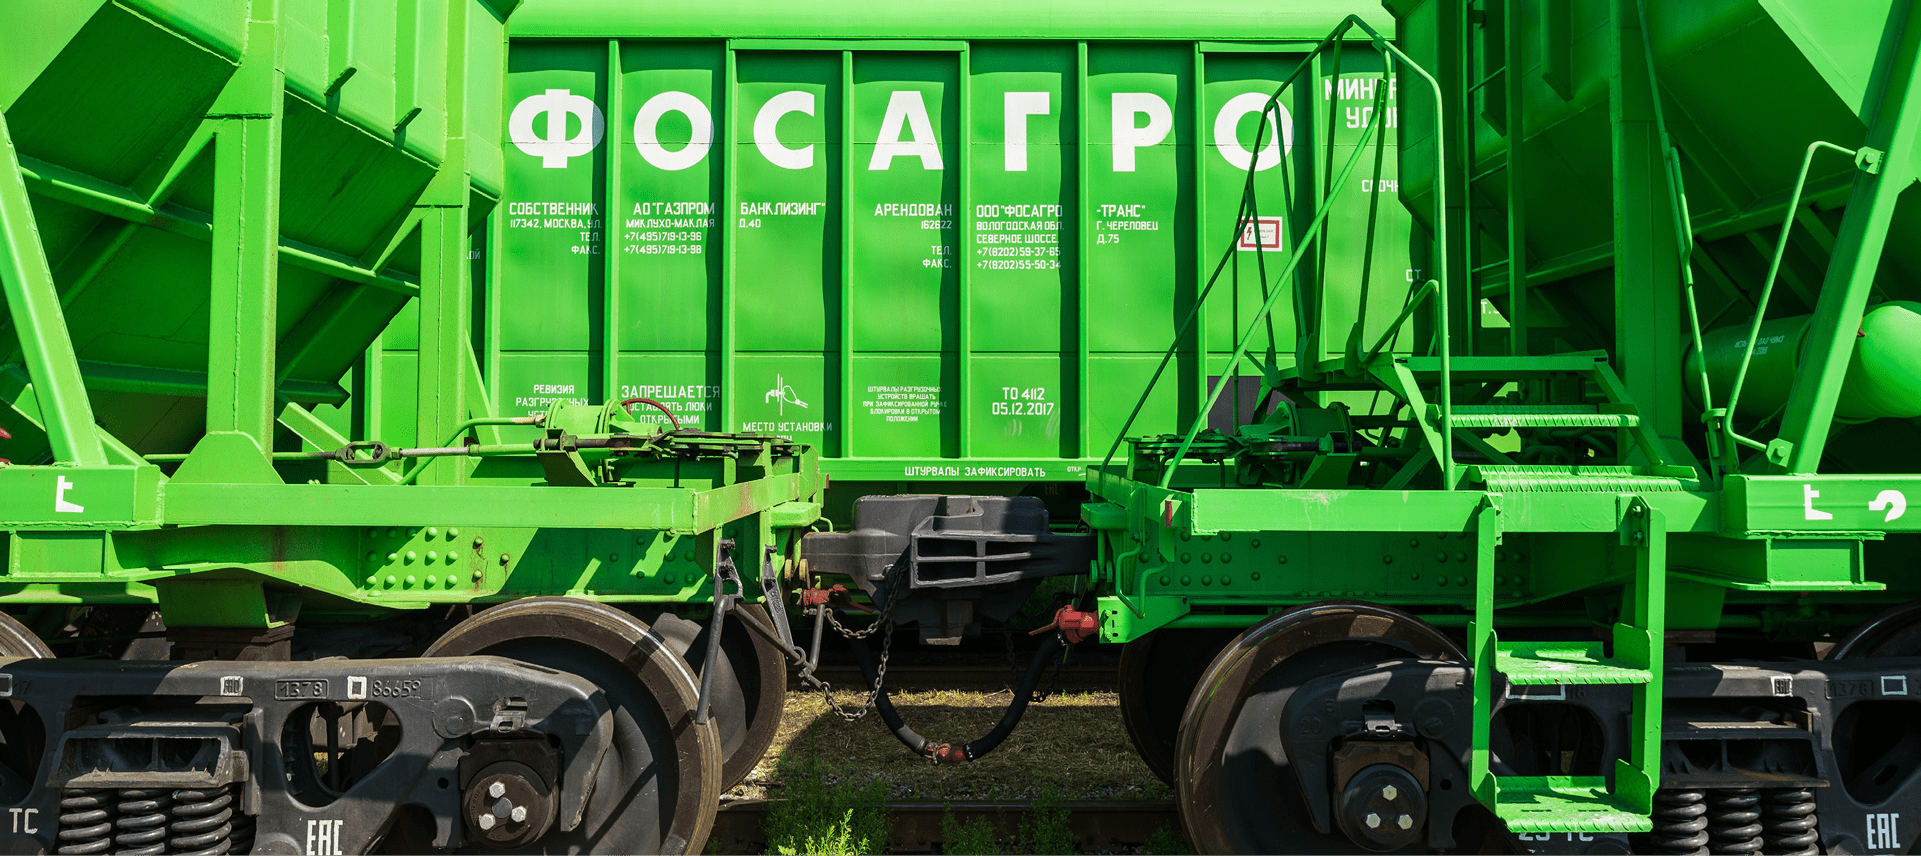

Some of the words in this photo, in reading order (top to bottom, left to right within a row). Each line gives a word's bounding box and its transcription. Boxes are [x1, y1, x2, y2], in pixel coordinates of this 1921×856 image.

[1325, 79, 1397, 100] МИНР
[509, 89, 1293, 171] ФОСАГРО
[509, 202, 599, 215] СОБСТВЕННИК
[633, 202, 650, 215] АО
[652, 202, 715, 215] "ГАЗПРОМ
[741, 202, 826, 215] БАНКЛИЗИНГ"
[874, 203, 952, 217] АРЕНДОВАН
[976, 205, 999, 217] ООО
[1000, 205, 1063, 217] "ФОСАГРО
[1096, 205, 1146, 217] -ТРАНС"
[510, 218, 542, 229] 117342,
[626, 218, 715, 229] МИКЛУХО-МАКЛАЯ
[739, 218, 761, 228] Д.40
[921, 220, 952, 229] 162622
[976, 221, 1042, 230] ВОЛОГОДСКАЯ
[1044, 221, 1064, 230] ОБЛ.
[1096, 221, 1105, 230] Г.
[1106, 221, 1159, 230] ЧЕРЕПОВЕЦ
[580, 232, 600, 241] ТЕЛ.
[624, 231, 702, 241] +7(495)719-13-96
[976, 234, 1023, 243] СЕВЕРНОЕ
[1096, 234, 1120, 245] Д.75
[571, 245, 600, 255] ФАКС.
[624, 245, 702, 254] +7(495)719-13-98
[931, 246, 952, 255] ТЕЛ.
[922, 259, 952, 268] ФАКС.
[977, 260, 1061, 269] +7(8202)55-50-34
[533, 384, 575, 394] РЕВИЗИЯ
[621, 385, 720, 398] ЗАПРЕЩАЕТСЯ
[1002, 387, 1018, 400] ТО
[1021, 387, 1045, 400] 4112
[515, 397, 589, 406] РАЗГРУНЫХ
[684, 402, 712, 411] ЛЮКИ
[992, 403, 1054, 415] 05.12.2017
[640, 415, 699, 424] ОТКРЫЫМИ
[743, 422, 775, 431] МЕСТО
[778, 422, 833, 431] УСТАНОВКИ
[905, 466, 959, 476] ШТУРВАЛЫ
[965, 467, 1046, 477] ЗАФИКСИРОВАТЬ
[280, 682, 324, 697] 1378
[1866, 813, 1901, 849] EAC
[306, 819, 343, 855] EAC
